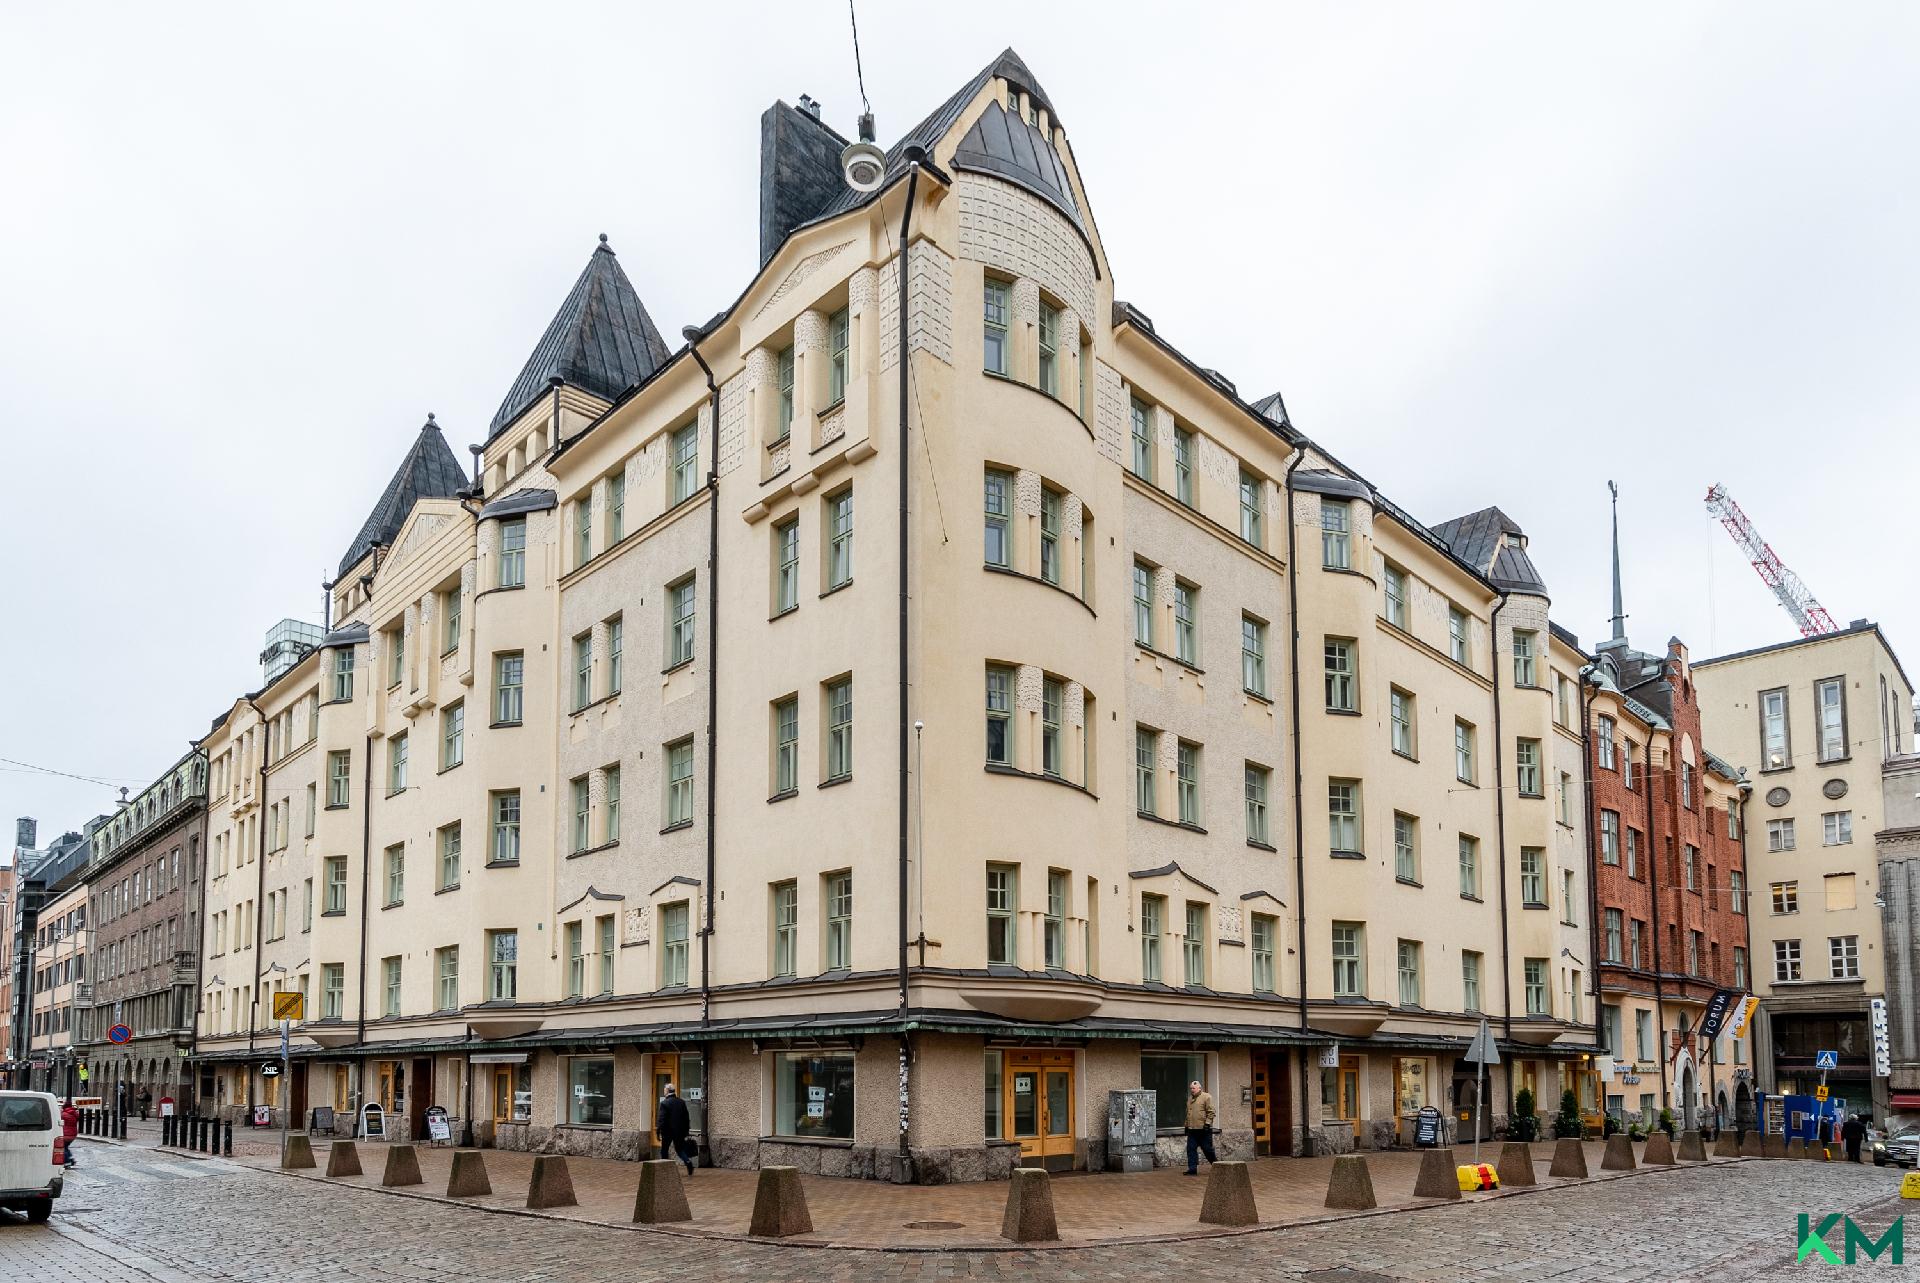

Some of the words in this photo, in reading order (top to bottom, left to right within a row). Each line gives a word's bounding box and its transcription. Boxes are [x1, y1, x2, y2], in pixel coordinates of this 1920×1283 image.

[1705, 995, 1726, 1034] FORUM
[1873, 1002, 1885, 1075] SIMHALL
[264, 1066, 278, 1074] NP
